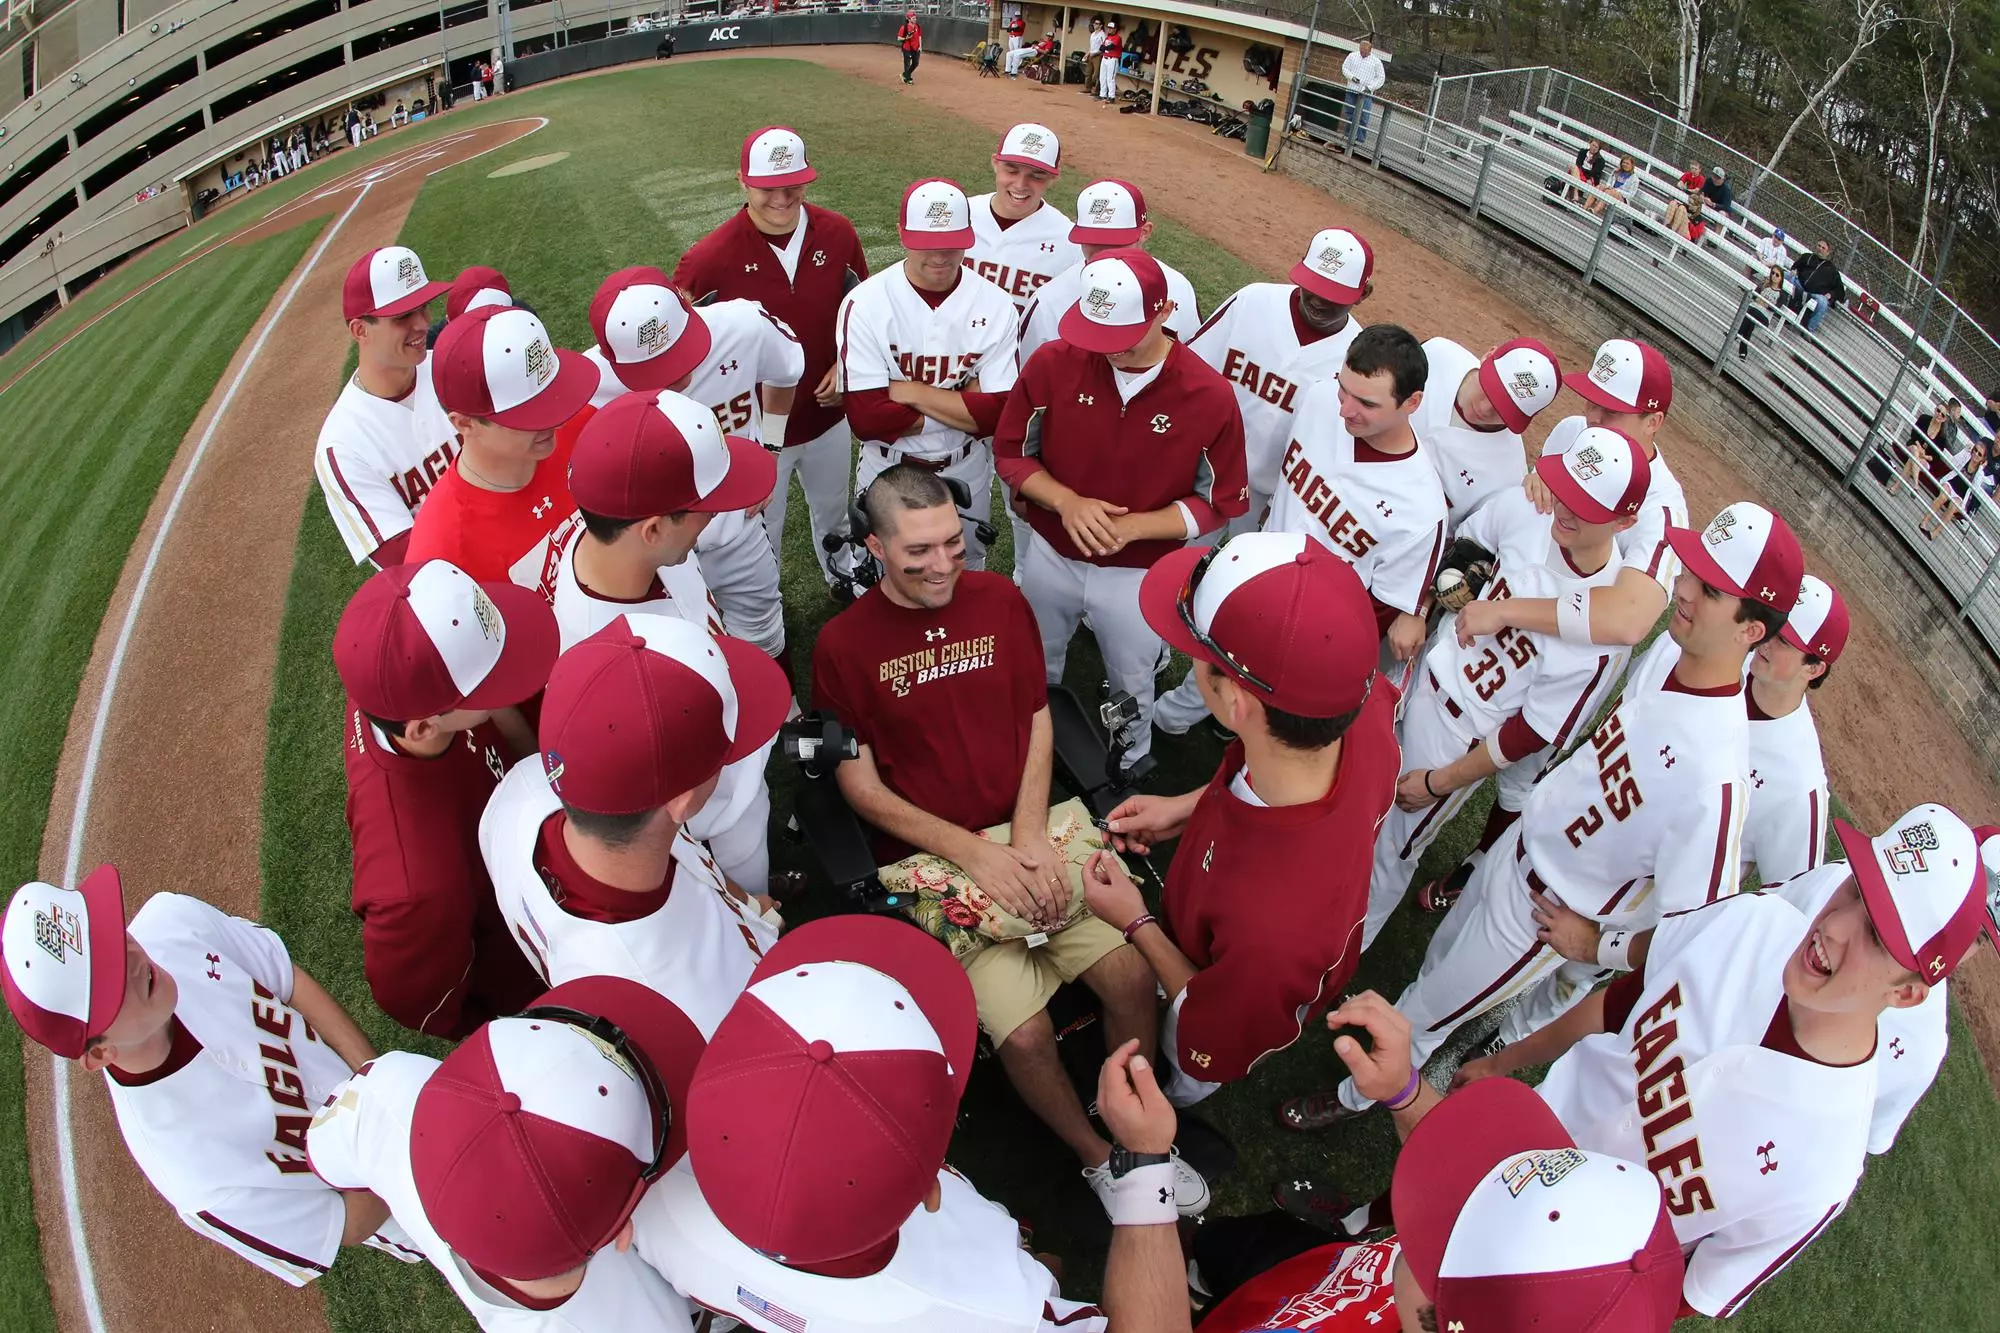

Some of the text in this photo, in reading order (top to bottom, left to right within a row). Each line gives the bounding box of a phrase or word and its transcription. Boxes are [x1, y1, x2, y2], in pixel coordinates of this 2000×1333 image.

[708, 26, 741, 42] ACC
[1221, 347, 1299, 415] EAGL
[1281, 437, 1380, 559] EAGLES
[879, 635, 996, 683] BOSTON COLLEGE
[916, 653, 995, 685] BASEBALL
[1463, 648, 1508, 702] 33
[1564, 804, 1605, 849] 2
[1188, 1047, 1212, 1068] 18
[1630, 980, 1716, 1217] EAGLES
